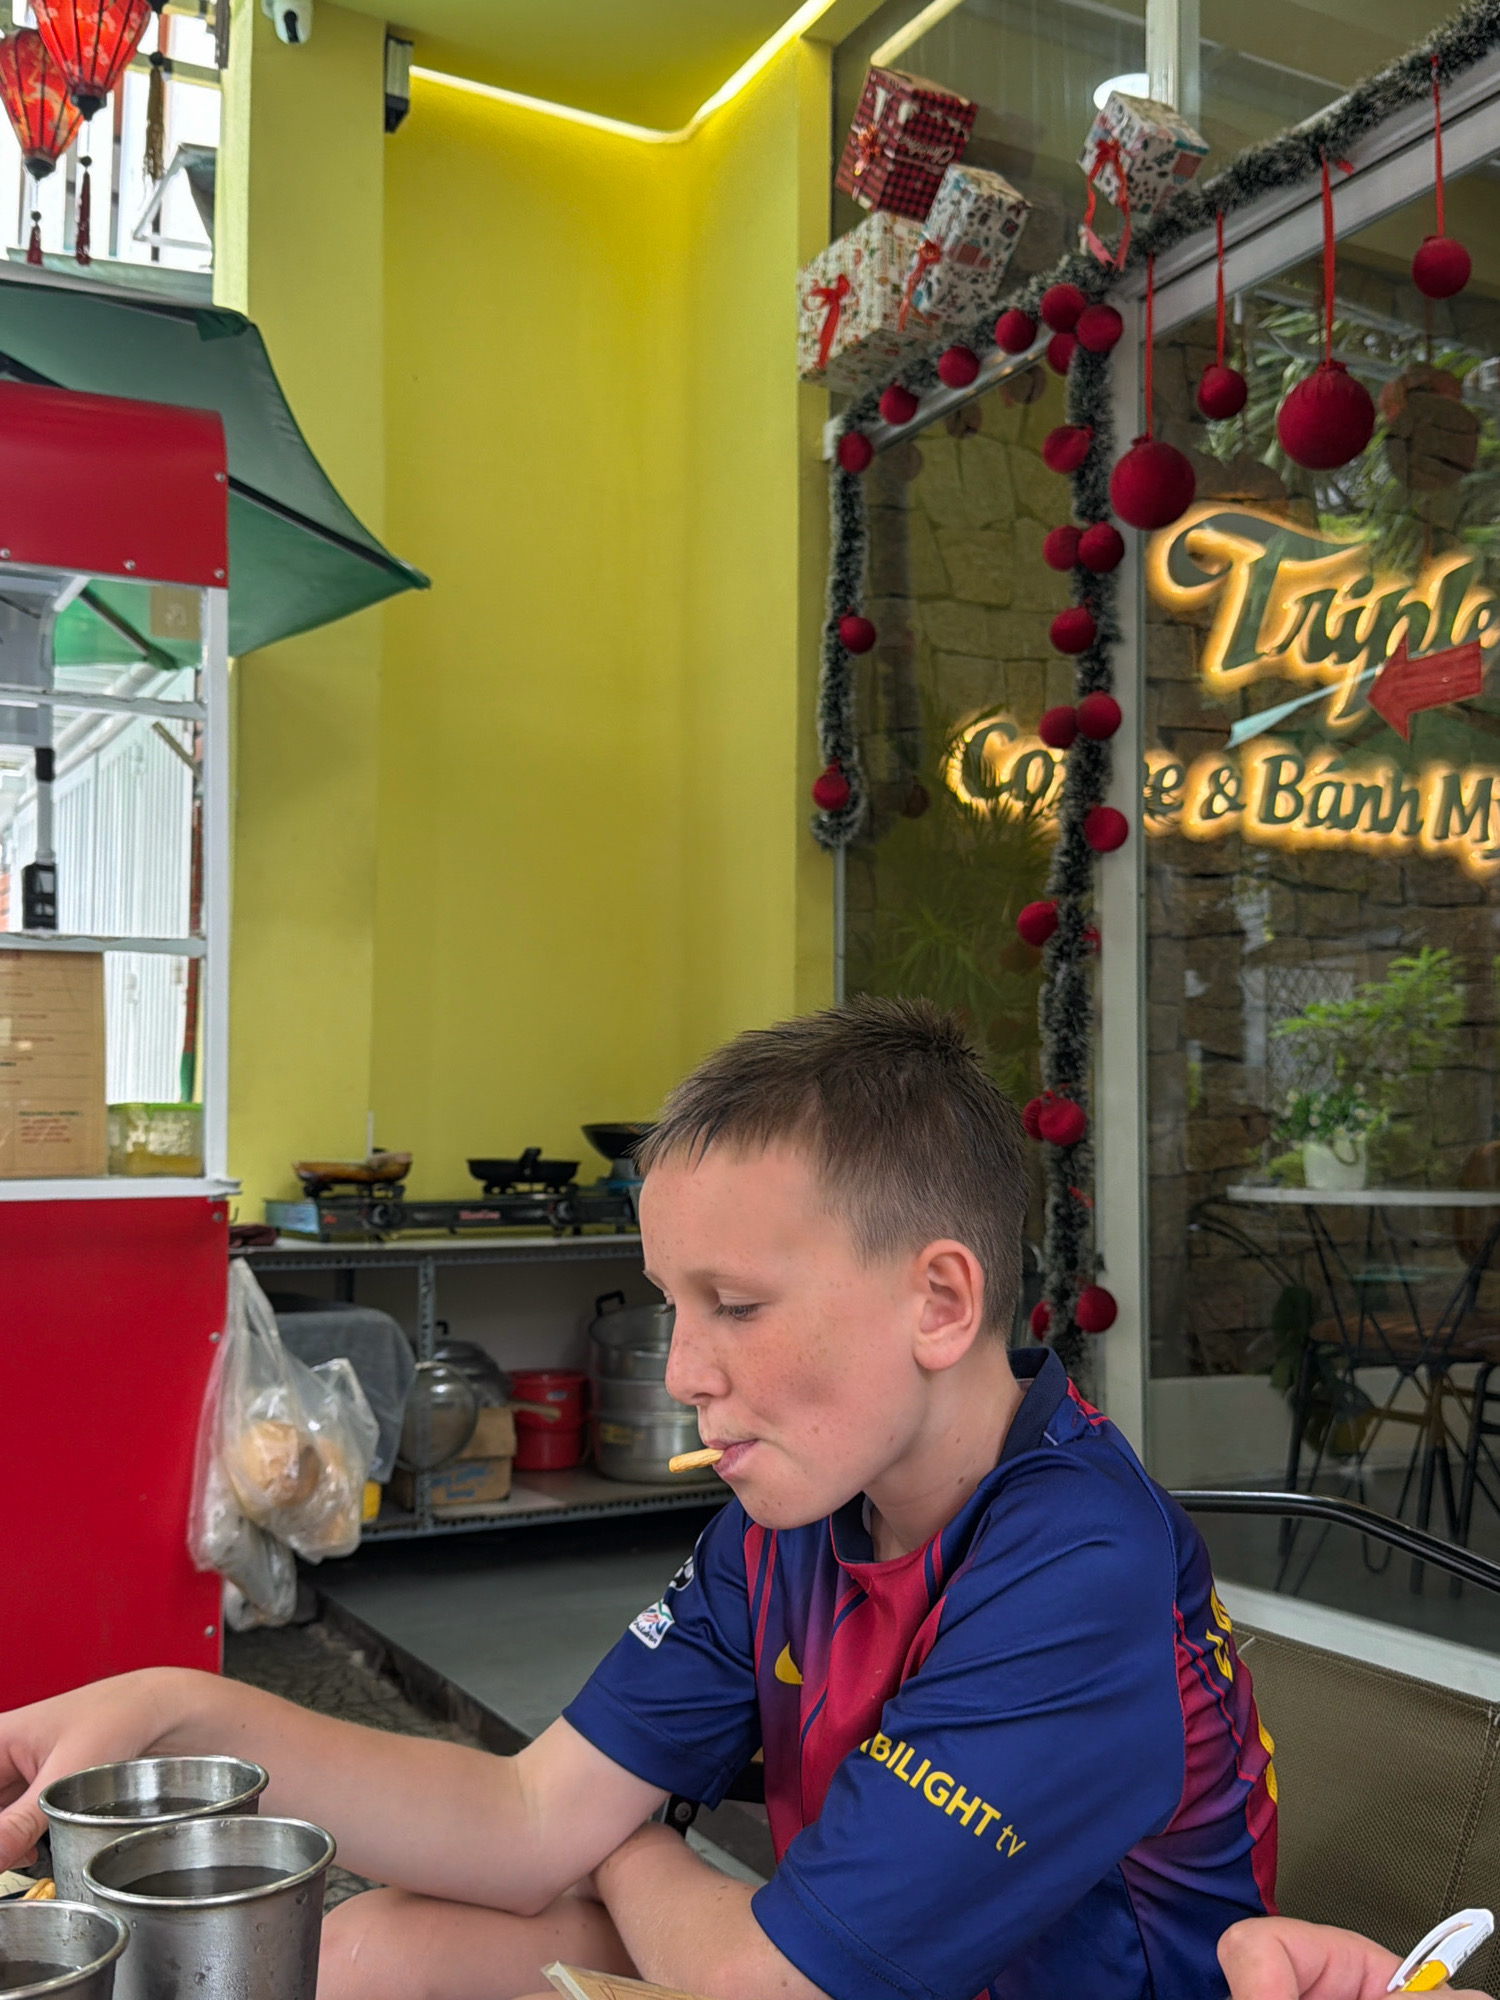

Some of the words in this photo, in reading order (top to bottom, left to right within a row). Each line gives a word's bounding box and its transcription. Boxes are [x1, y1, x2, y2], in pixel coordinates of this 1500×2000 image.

[1200, 765, 1246, 820] &
[1259, 754, 1424, 836] Bánh
[860, 1730, 1002, 1837] BILIGHT
[996, 1824, 1027, 1858] tv
